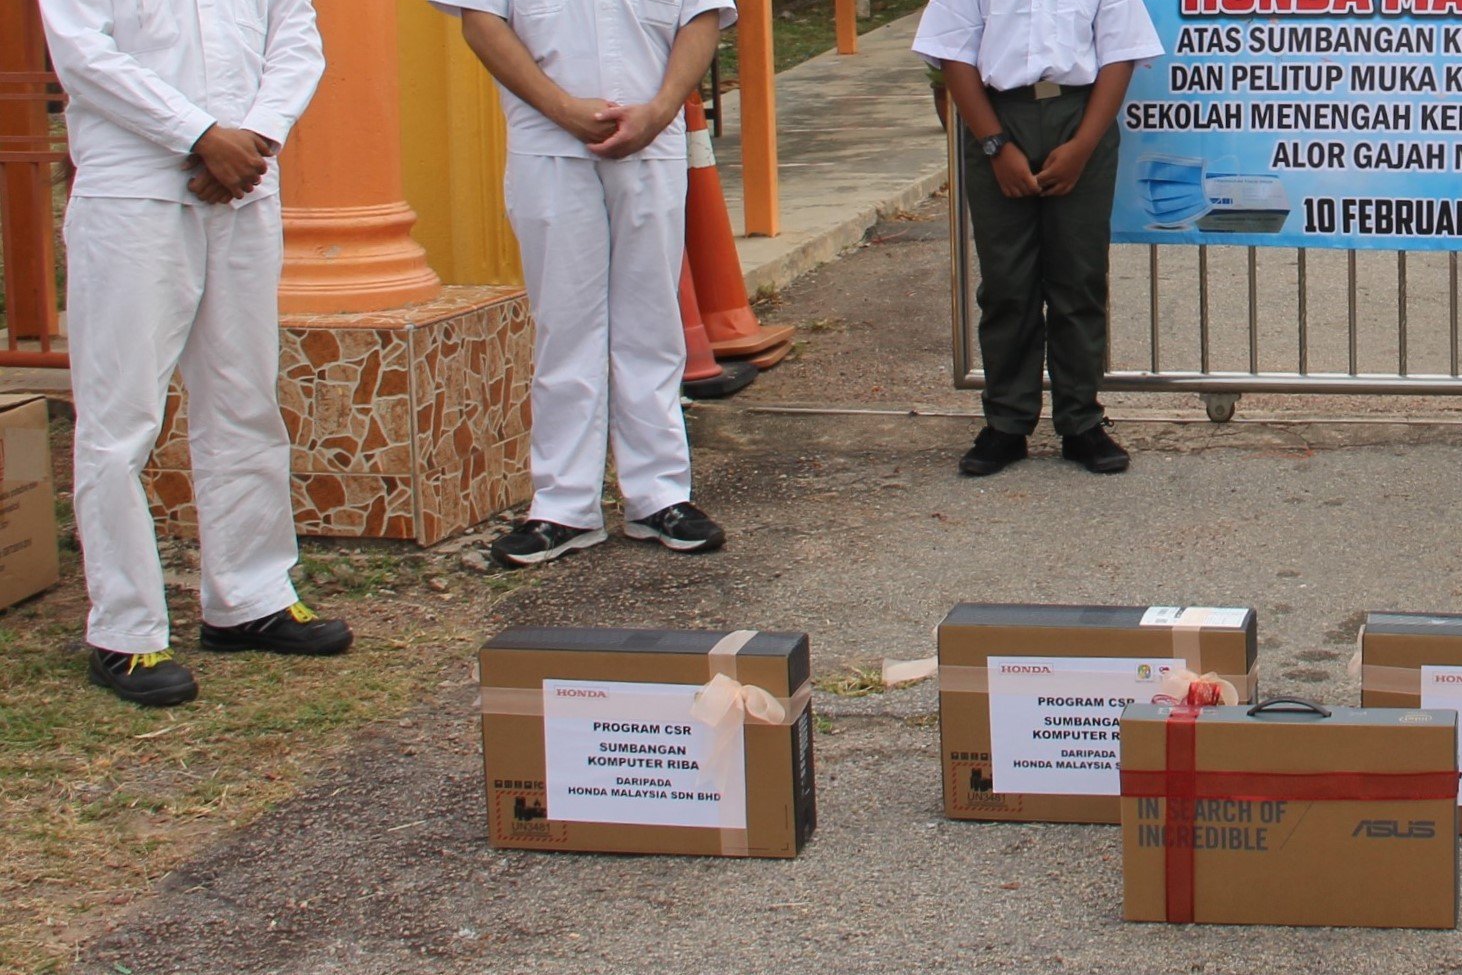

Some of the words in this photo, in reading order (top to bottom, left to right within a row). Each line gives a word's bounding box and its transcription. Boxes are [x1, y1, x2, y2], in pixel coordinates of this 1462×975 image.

[1178, 28, 1240, 53] ATAS
[1249, 27, 1433, 52] SUMBANGAN
[1172, 66, 1222, 91] DAN
[1232, 66, 1342, 91] PELITUP
[1351, 66, 1436, 91] MUKA
[1126, 104, 1241, 129] SEKOLAH
[1252, 104, 1410, 130] MENENGAH
[1272, 142, 1344, 168] ALOR
[1354, 143, 1444, 169] GAJAH
[1304, 199, 1335, 232] 10
[1001, 664, 1051, 674] HONDA
[556, 688, 607, 698] HONDA
[1038, 697, 1103, 706] PROGRAM
[1044, 716, 1120, 727] SUMBANGA
[594, 723, 659, 733] PROGRAM
[665, 726, 691, 735] CSR
[1033, 731, 1106, 740] KOMPUTER
[600, 743, 686, 755] SUMBANGAN
[1061, 750, 1116, 758] DARIPADA
[588, 756, 662, 768] KOMPUTER
[668, 760, 699, 769] RIBA
[616, 777, 672, 787] DARIPADA
[612, 789, 667, 798] MALAYSIA
[1137, 797, 1159, 819] IN
[1260, 801, 1288, 823] OF
[1351, 820, 1436, 838] ASUS
[1138, 825, 1268, 850] INCREDIBLE
